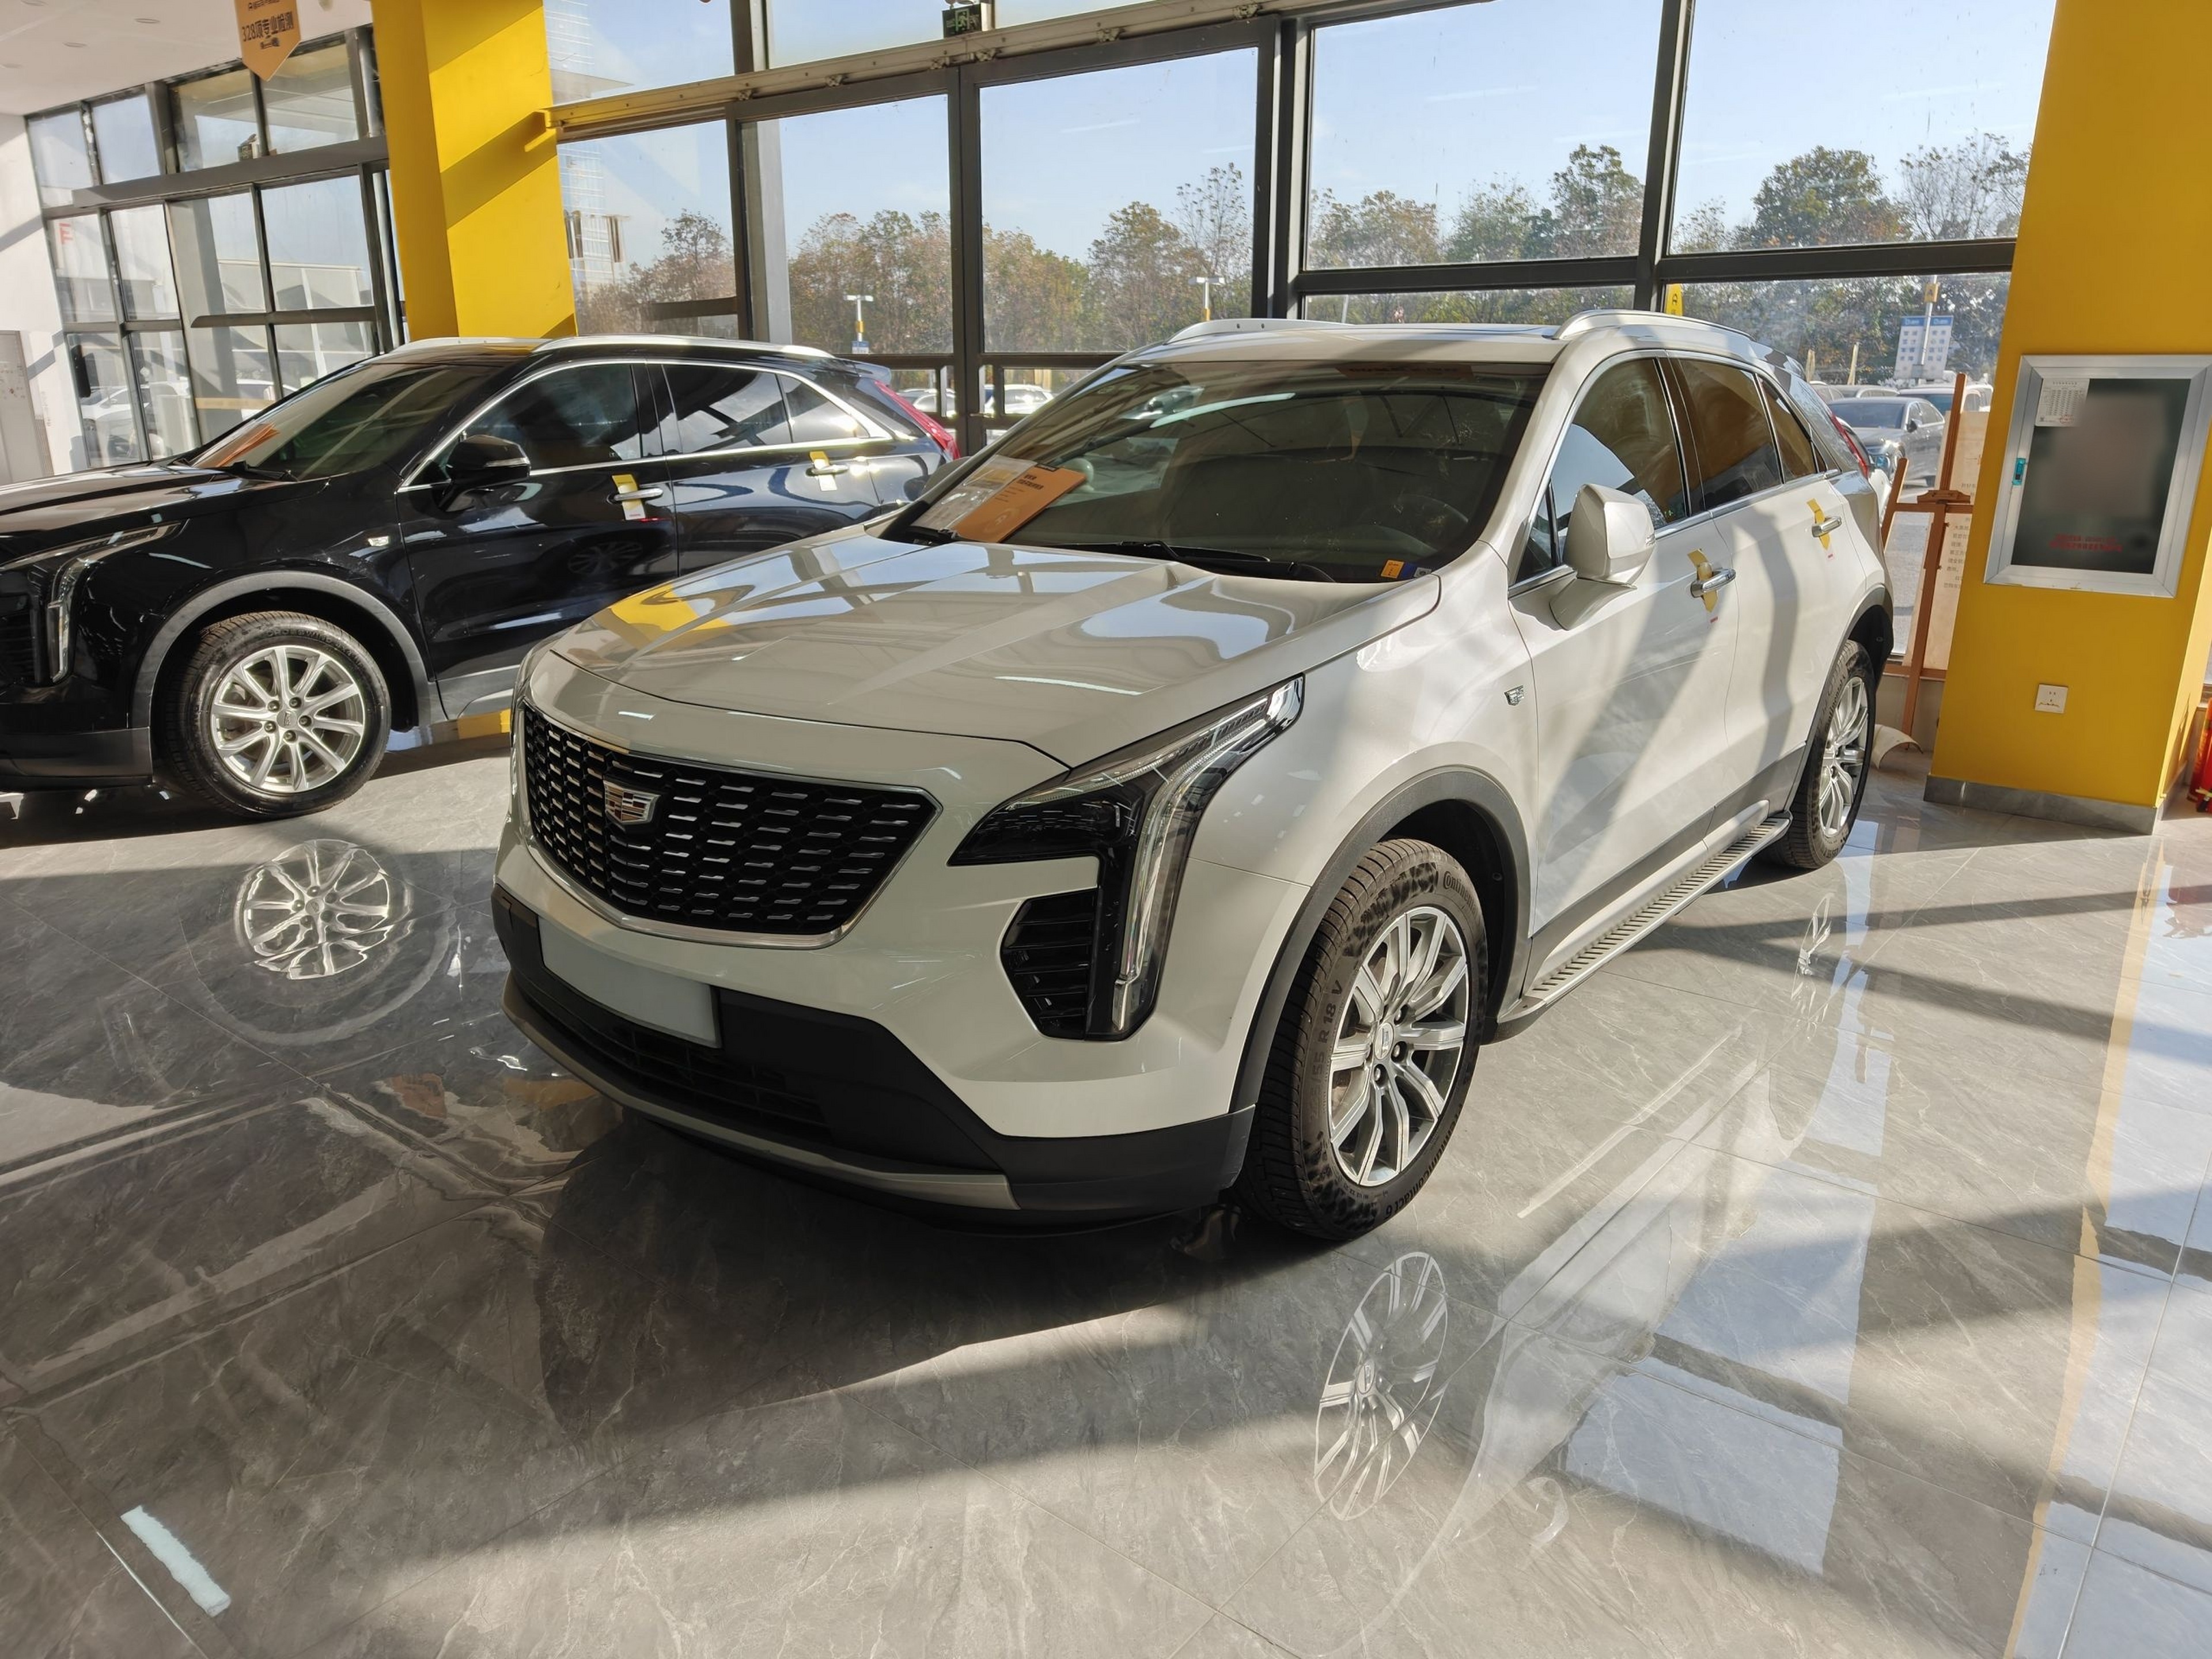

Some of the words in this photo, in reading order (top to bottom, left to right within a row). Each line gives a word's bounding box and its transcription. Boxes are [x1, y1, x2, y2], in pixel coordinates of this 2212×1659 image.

[242, 11, 294, 41] 328项专业检测
[1317, 1029, 1330, 1043] R
[1324, 1002, 1336, 1023] 18
[1331, 980, 1342, 994] V
